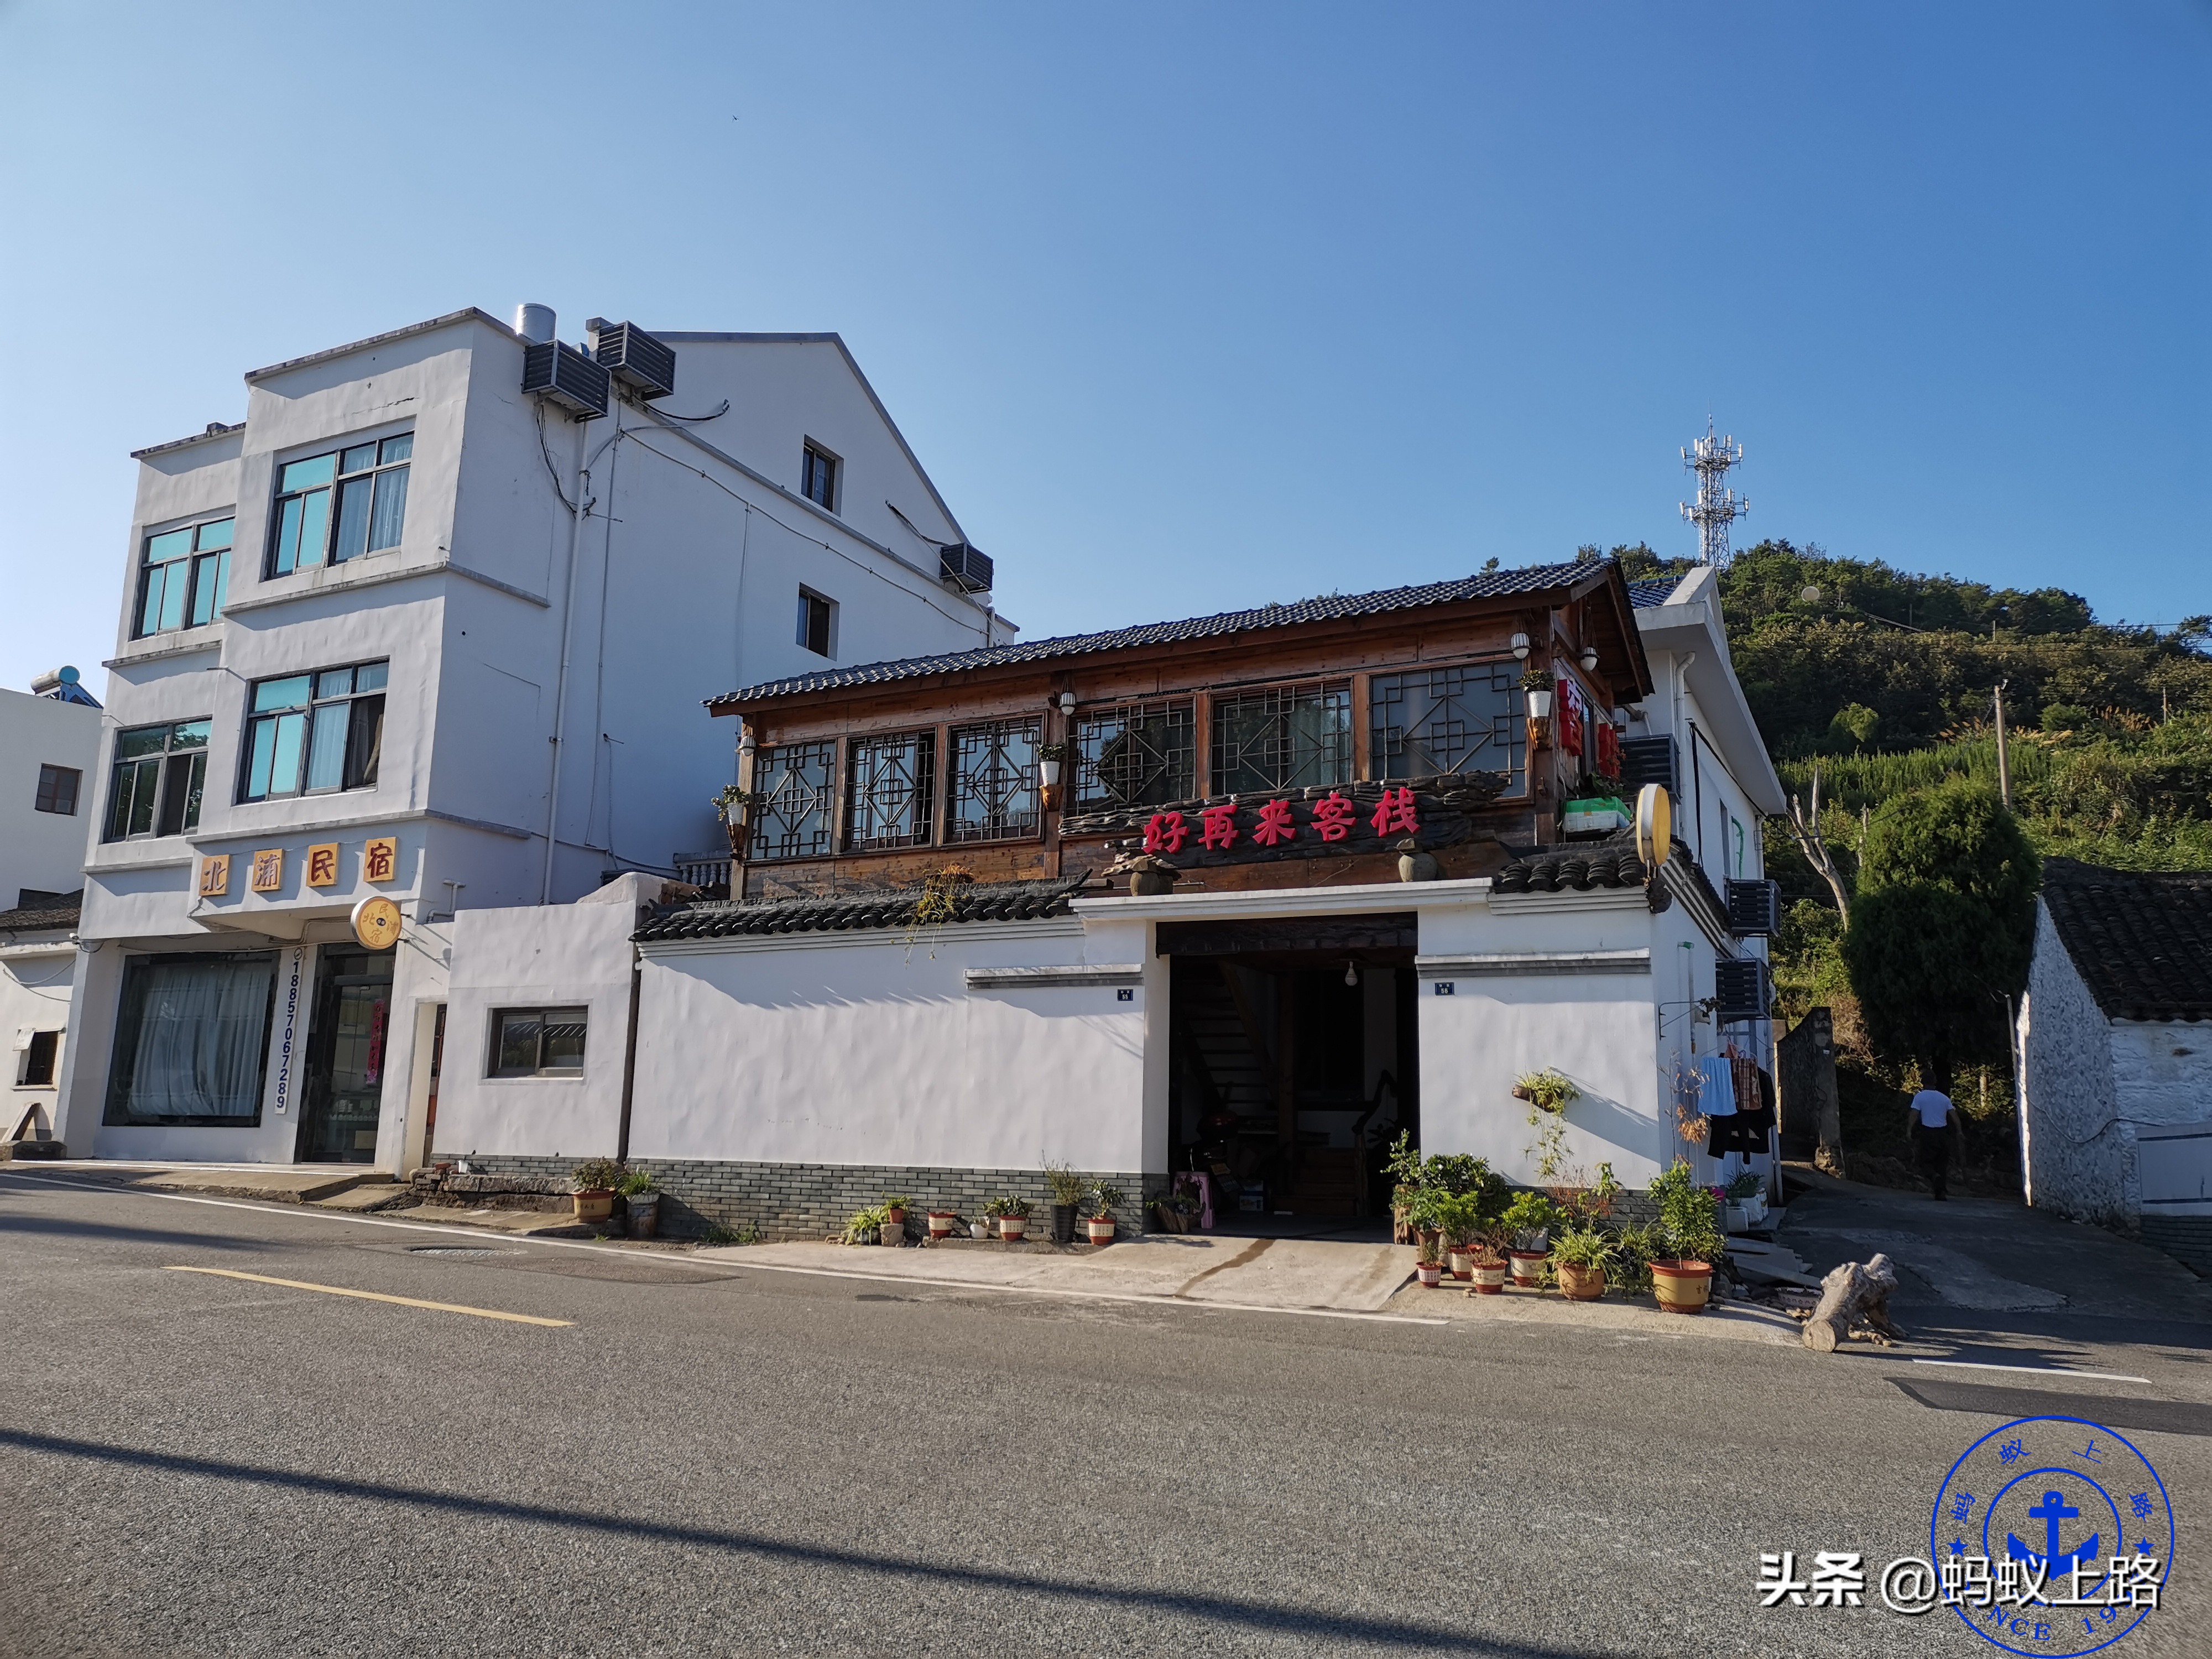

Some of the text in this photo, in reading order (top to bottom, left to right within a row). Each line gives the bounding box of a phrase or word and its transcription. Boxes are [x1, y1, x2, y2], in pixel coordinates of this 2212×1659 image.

[1142, 786, 1421, 854] 好再来客栈
[202, 842, 393, 891] 北浦民宿
[276, 961, 299, 1109] 18857067289
